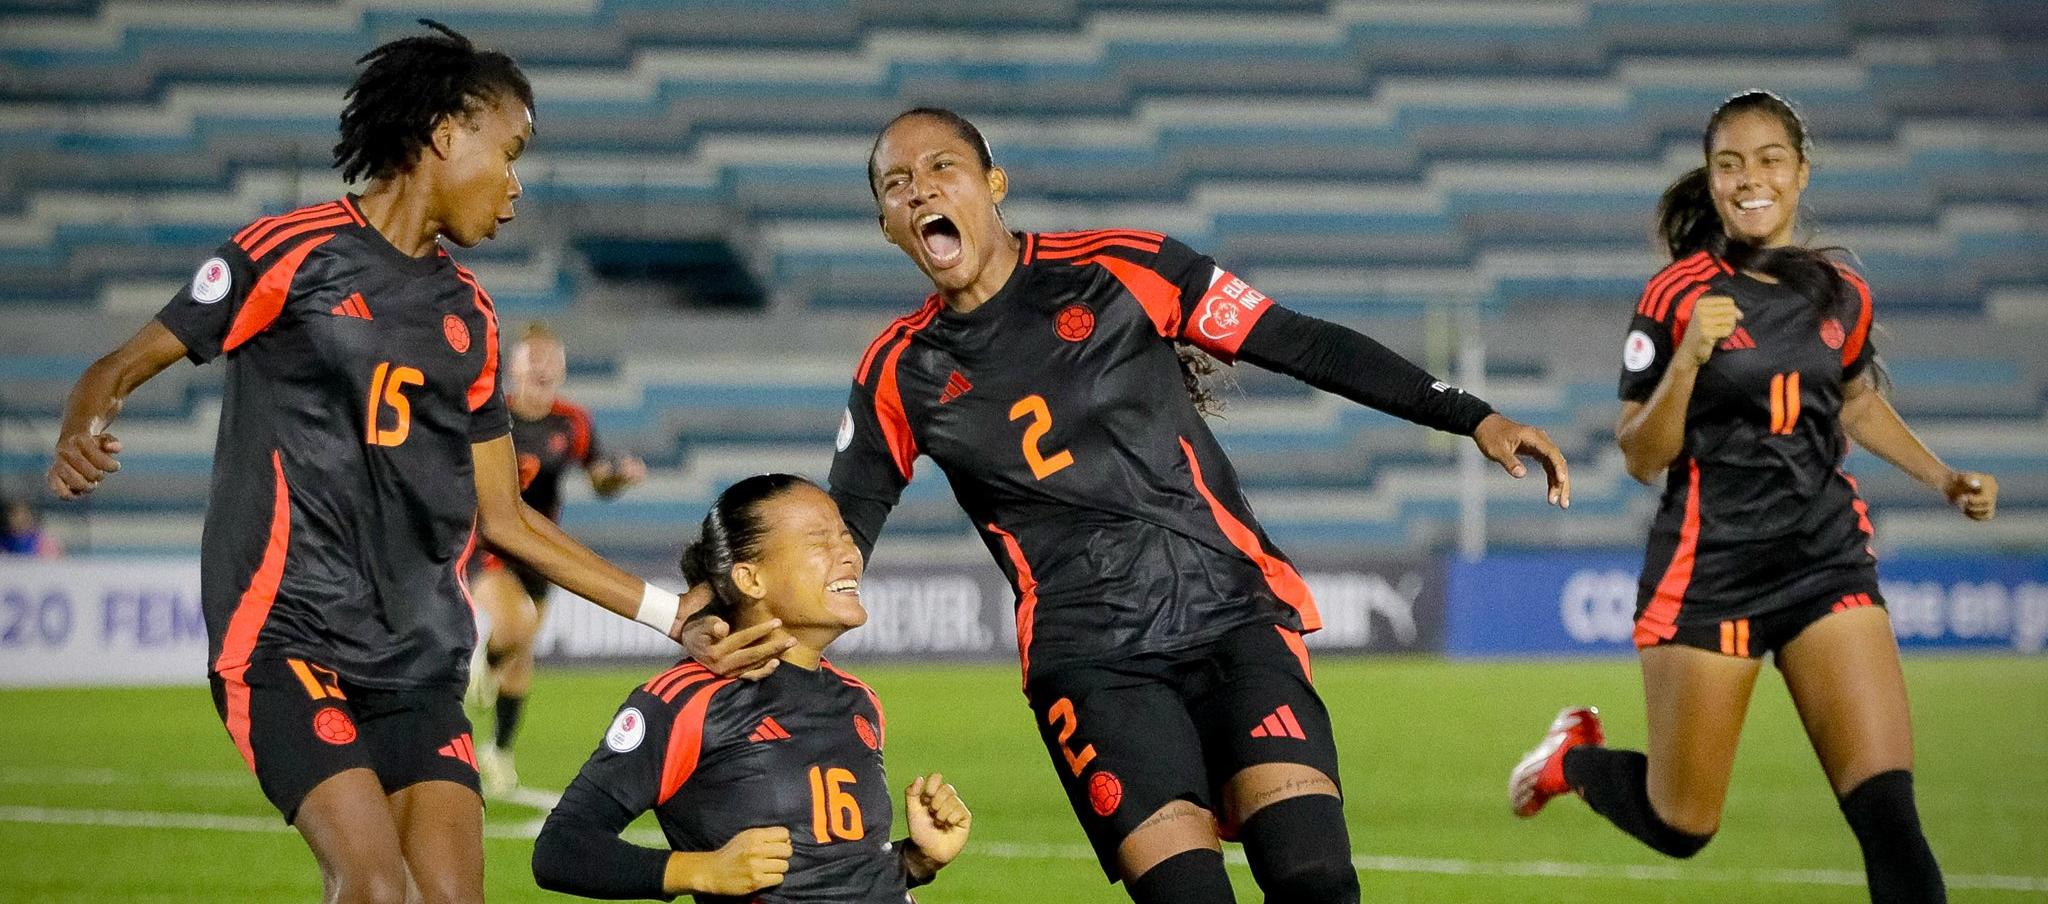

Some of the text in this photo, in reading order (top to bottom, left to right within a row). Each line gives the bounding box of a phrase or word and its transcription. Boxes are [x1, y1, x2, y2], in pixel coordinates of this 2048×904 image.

[366, 361, 425, 446] 15
[1009, 394, 1074, 481] 2
[1770, 371, 1800, 435] 11
[1720, 619, 1750, 659] 11
[1049, 697, 1097, 777] 2
[809, 766, 865, 844] 16
